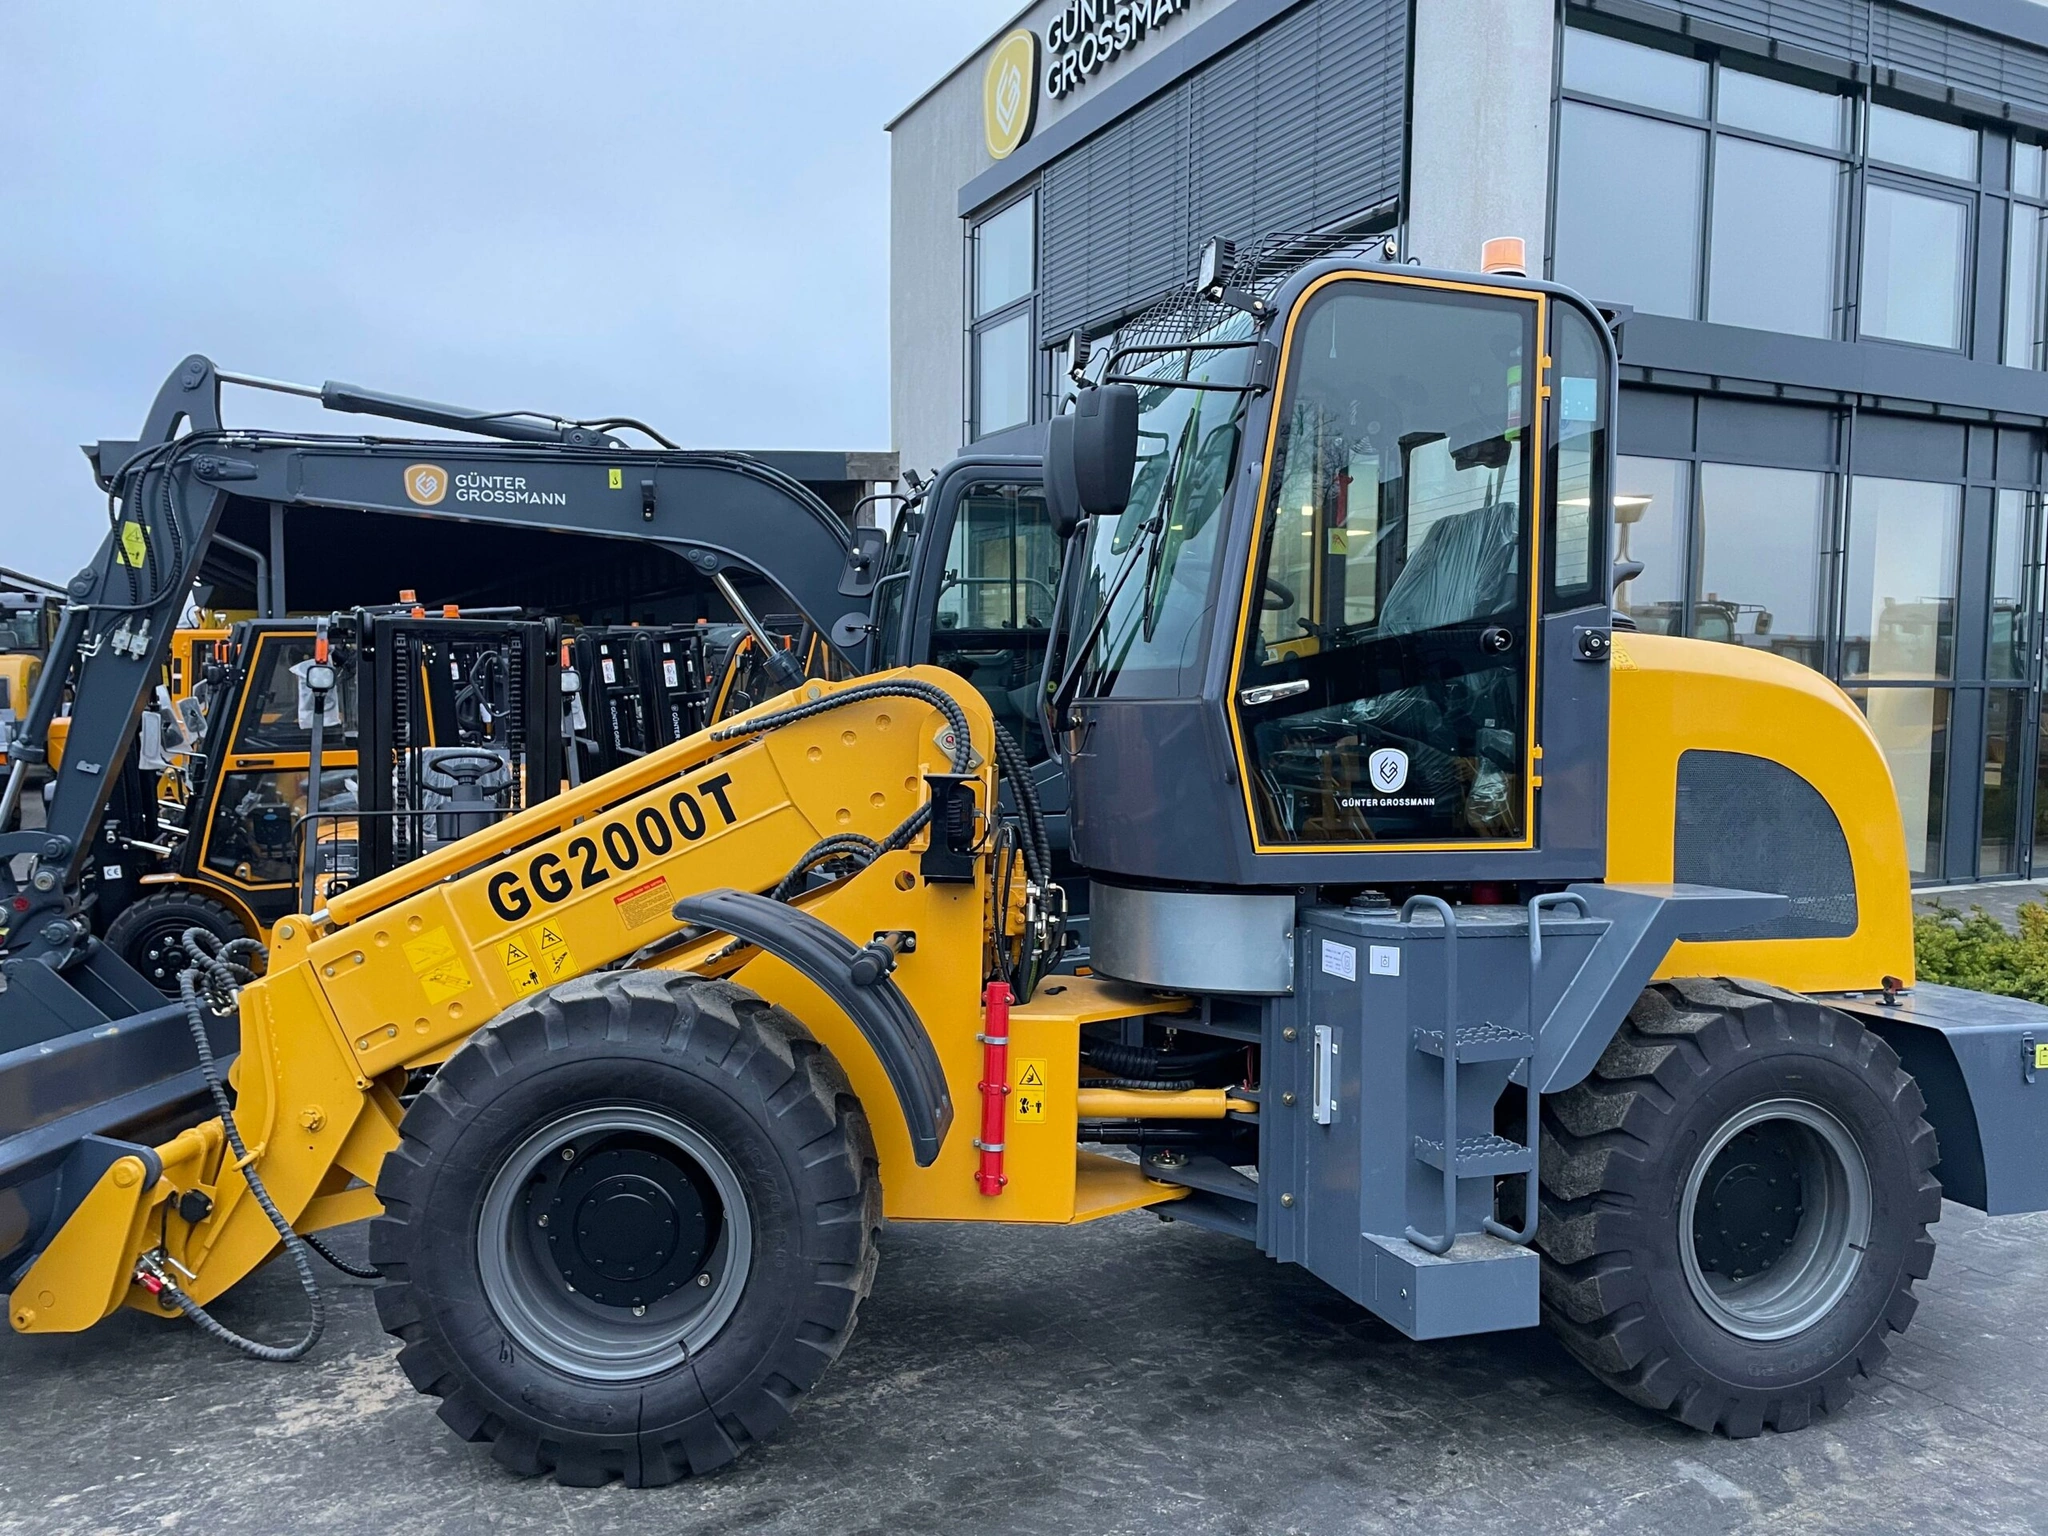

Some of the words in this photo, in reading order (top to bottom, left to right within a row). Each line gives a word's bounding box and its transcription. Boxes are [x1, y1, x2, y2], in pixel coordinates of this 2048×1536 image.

[455, 471, 527, 490] GÜNTER
[455, 488, 567, 506] GROSSMANN
[671, 712, 680, 739] GÜNTER
[1341, 797, 1378, 807] GÜNTER
[1380, 798, 1435, 807] GROSSMANN
[487, 772, 737, 922] GG2000T
[106, 868, 120, 877] CE
